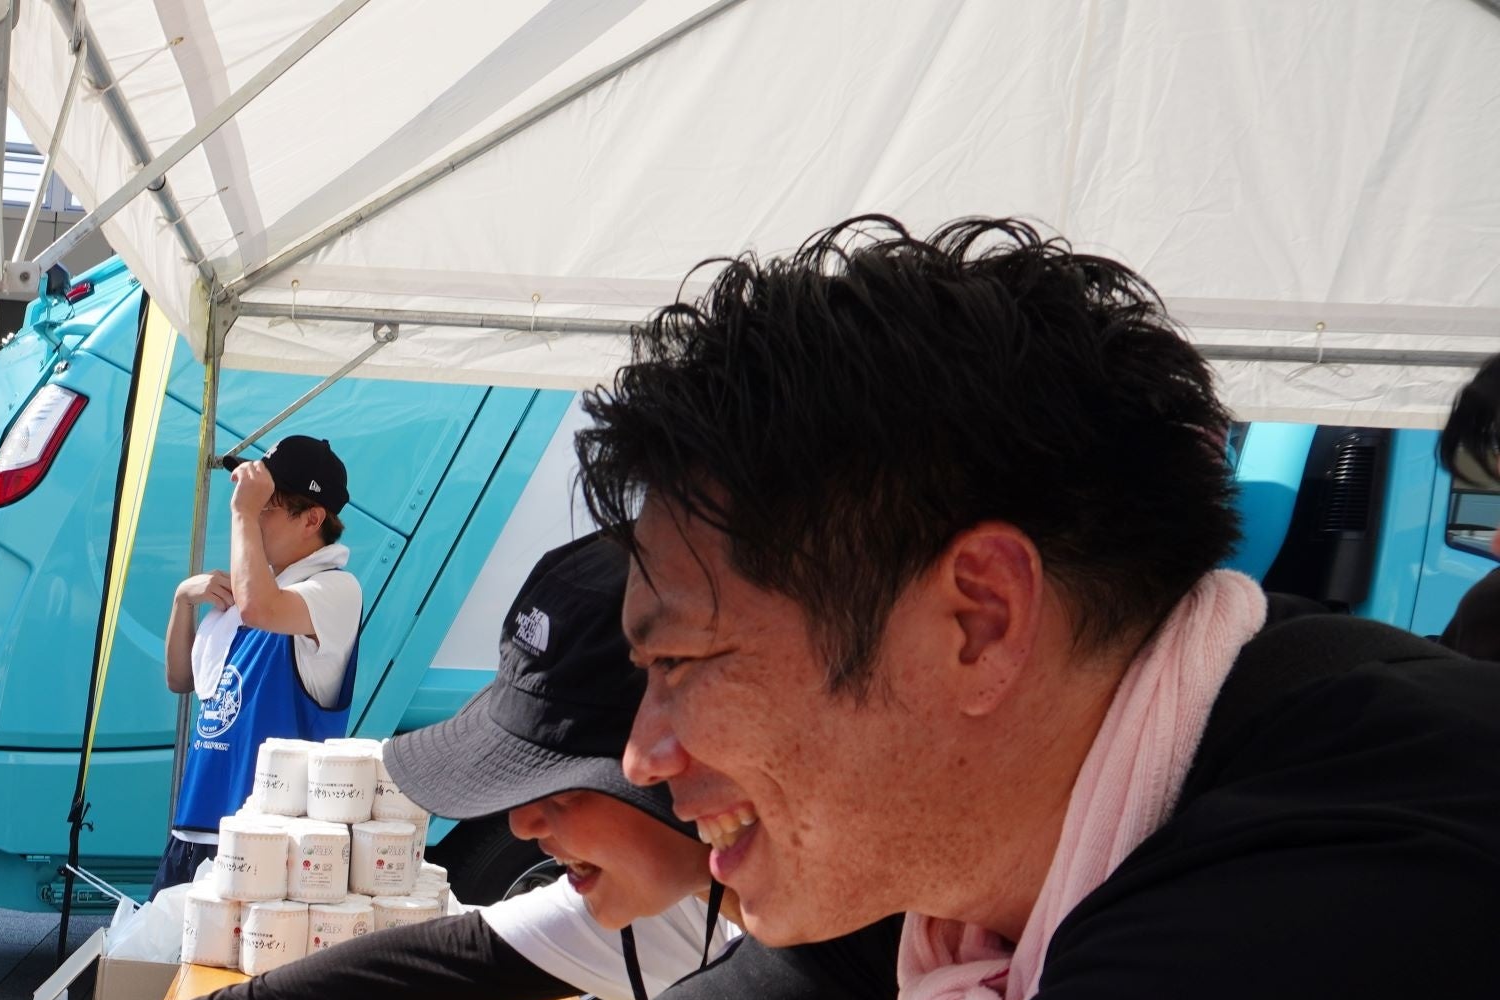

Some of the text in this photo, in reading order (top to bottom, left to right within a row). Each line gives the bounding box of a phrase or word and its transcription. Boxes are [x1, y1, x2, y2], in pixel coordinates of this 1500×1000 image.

[514, 611, 538, 633] NORTH
[529, 606, 544, 623] THE
[515, 629, 535, 645] FACE
